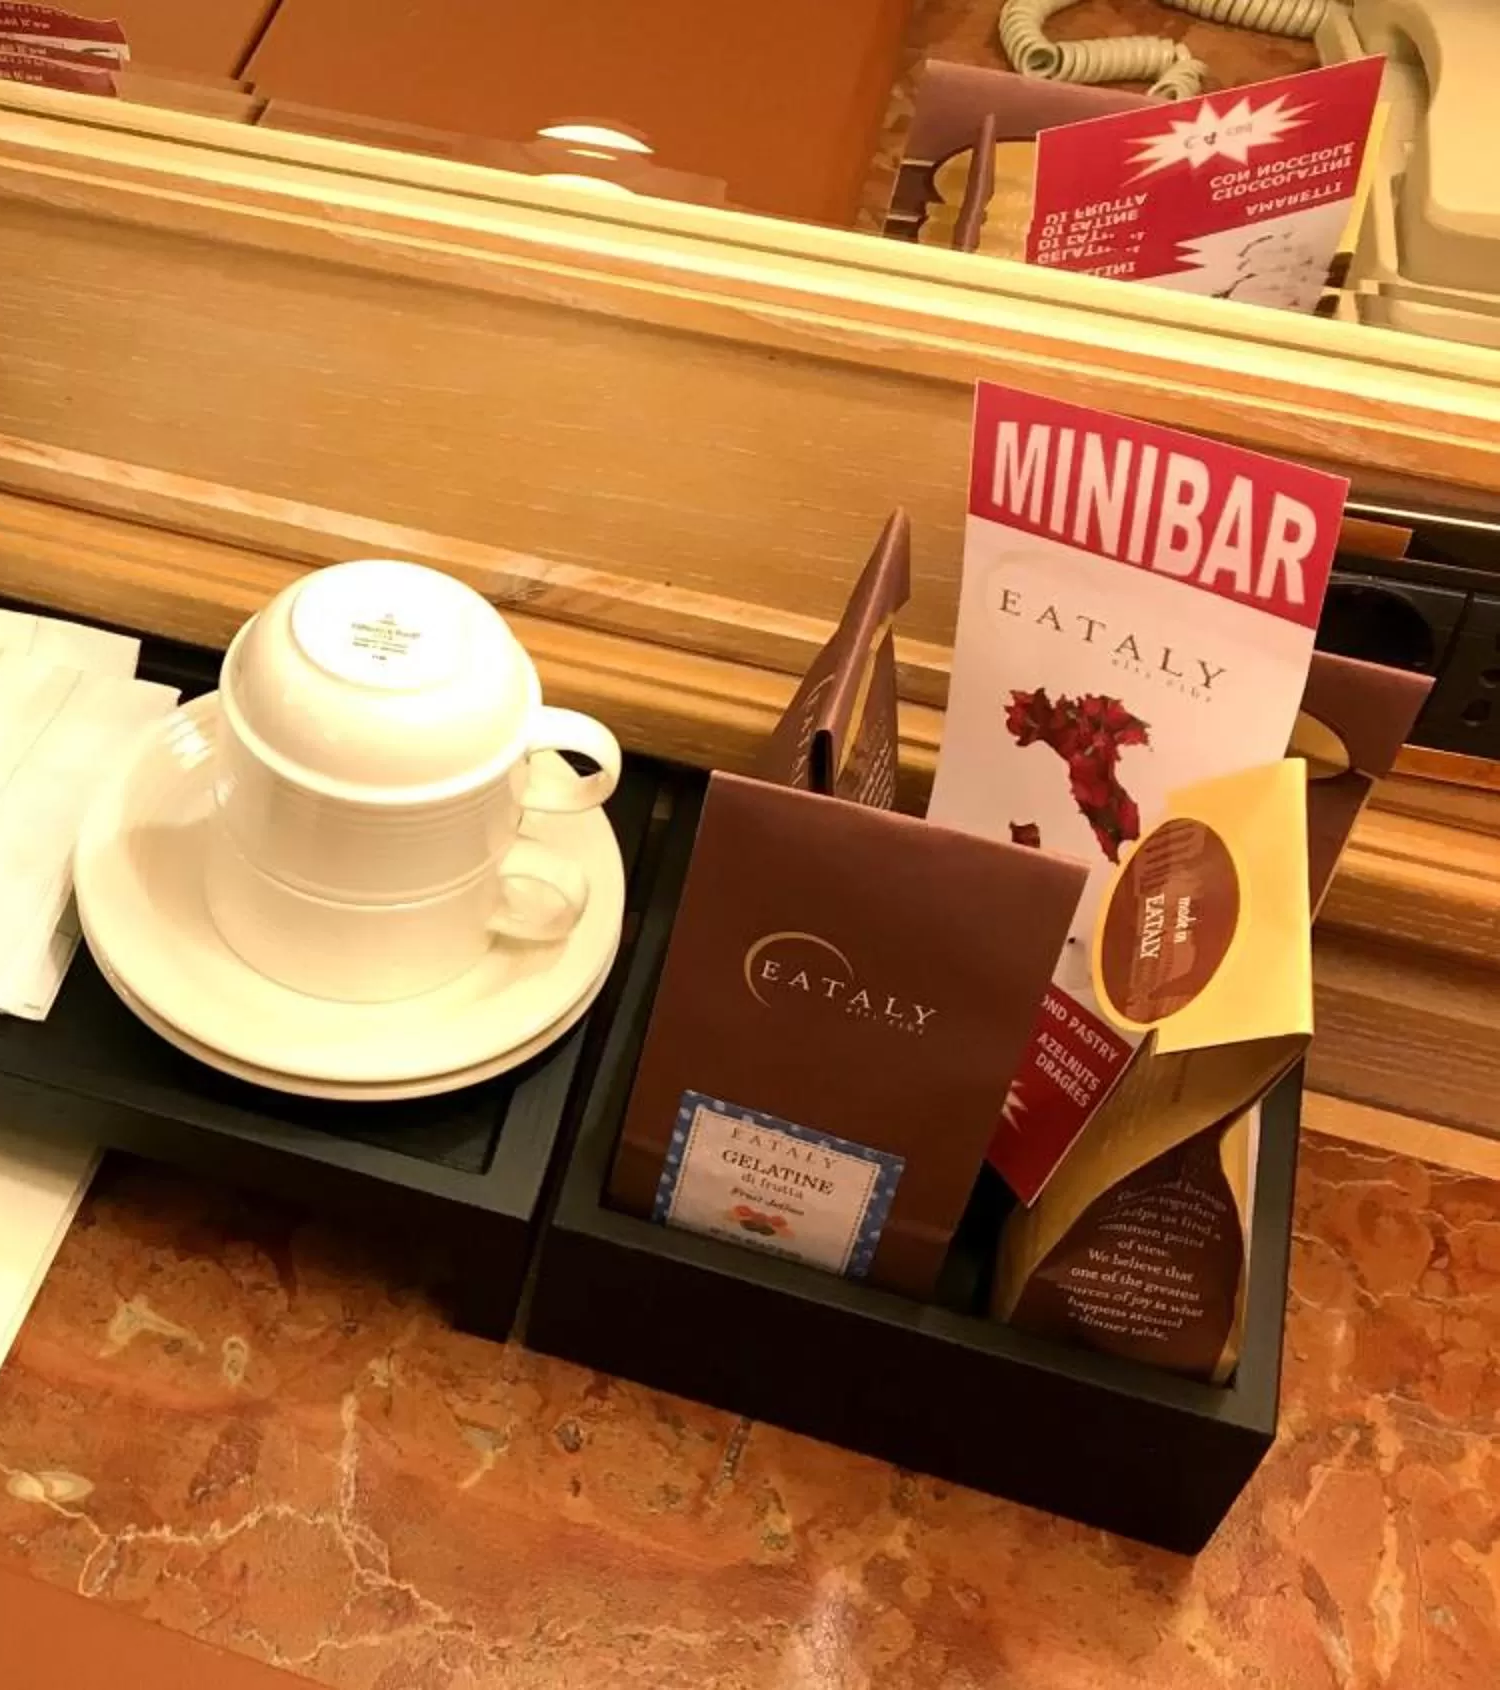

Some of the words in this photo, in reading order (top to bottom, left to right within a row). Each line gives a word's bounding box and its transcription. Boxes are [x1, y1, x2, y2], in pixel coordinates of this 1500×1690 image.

[991, 421, 1318, 606] MINIBAR
[998, 589, 1227, 689] EATALY
[1140, 892, 1165, 959] EATALY
[759, 958, 937, 1026] EATALY
[1067, 1016, 1120, 1063] PASTRY
[731, 1127, 837, 1169] EATALY
[722, 1149, 836, 1195] GELATINE
[760, 1178, 804, 1200] frutta
[1088, 1248, 1110, 1263] We
[1112, 1253, 1163, 1275] believe
[1165, 1264, 1195, 1283] that
[1117, 1239, 1136, 1251] of
[1071, 1266, 1099, 1281] one
[1100, 1270, 1120, 1283] of
[1120, 1273, 1143, 1288] the
[1144, 1283, 1201, 1302] greatest
[1112, 1291, 1133, 1303] of
[1129, 1311, 1184, 1329] around
